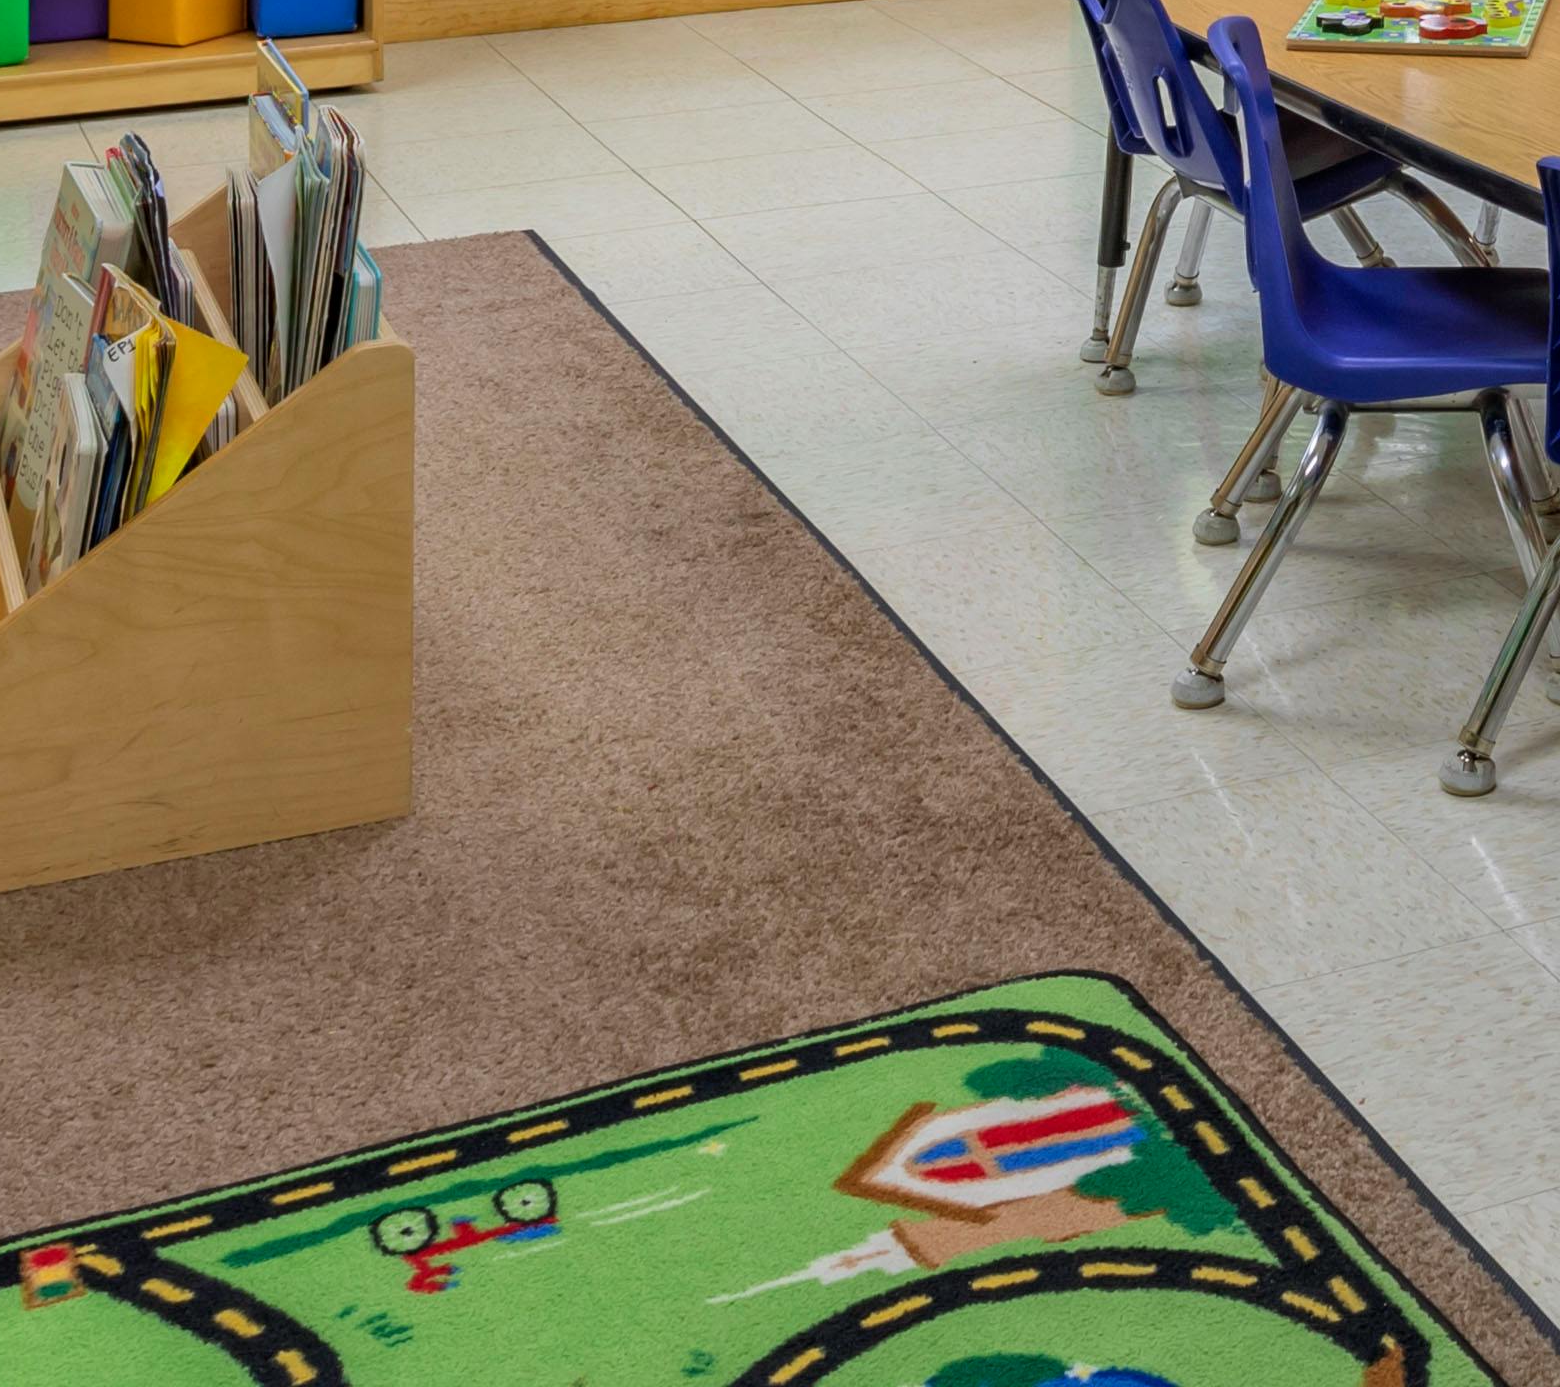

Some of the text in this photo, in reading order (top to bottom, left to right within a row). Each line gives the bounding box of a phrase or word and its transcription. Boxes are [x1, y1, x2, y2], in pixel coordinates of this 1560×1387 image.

[54, 294, 84, 342] Don't
[47, 326, 86, 374] Let the
[106, 337, 137, 363] EP1
[28, 426, 46, 460] the
[18, 453, 44, 498] Bus!
